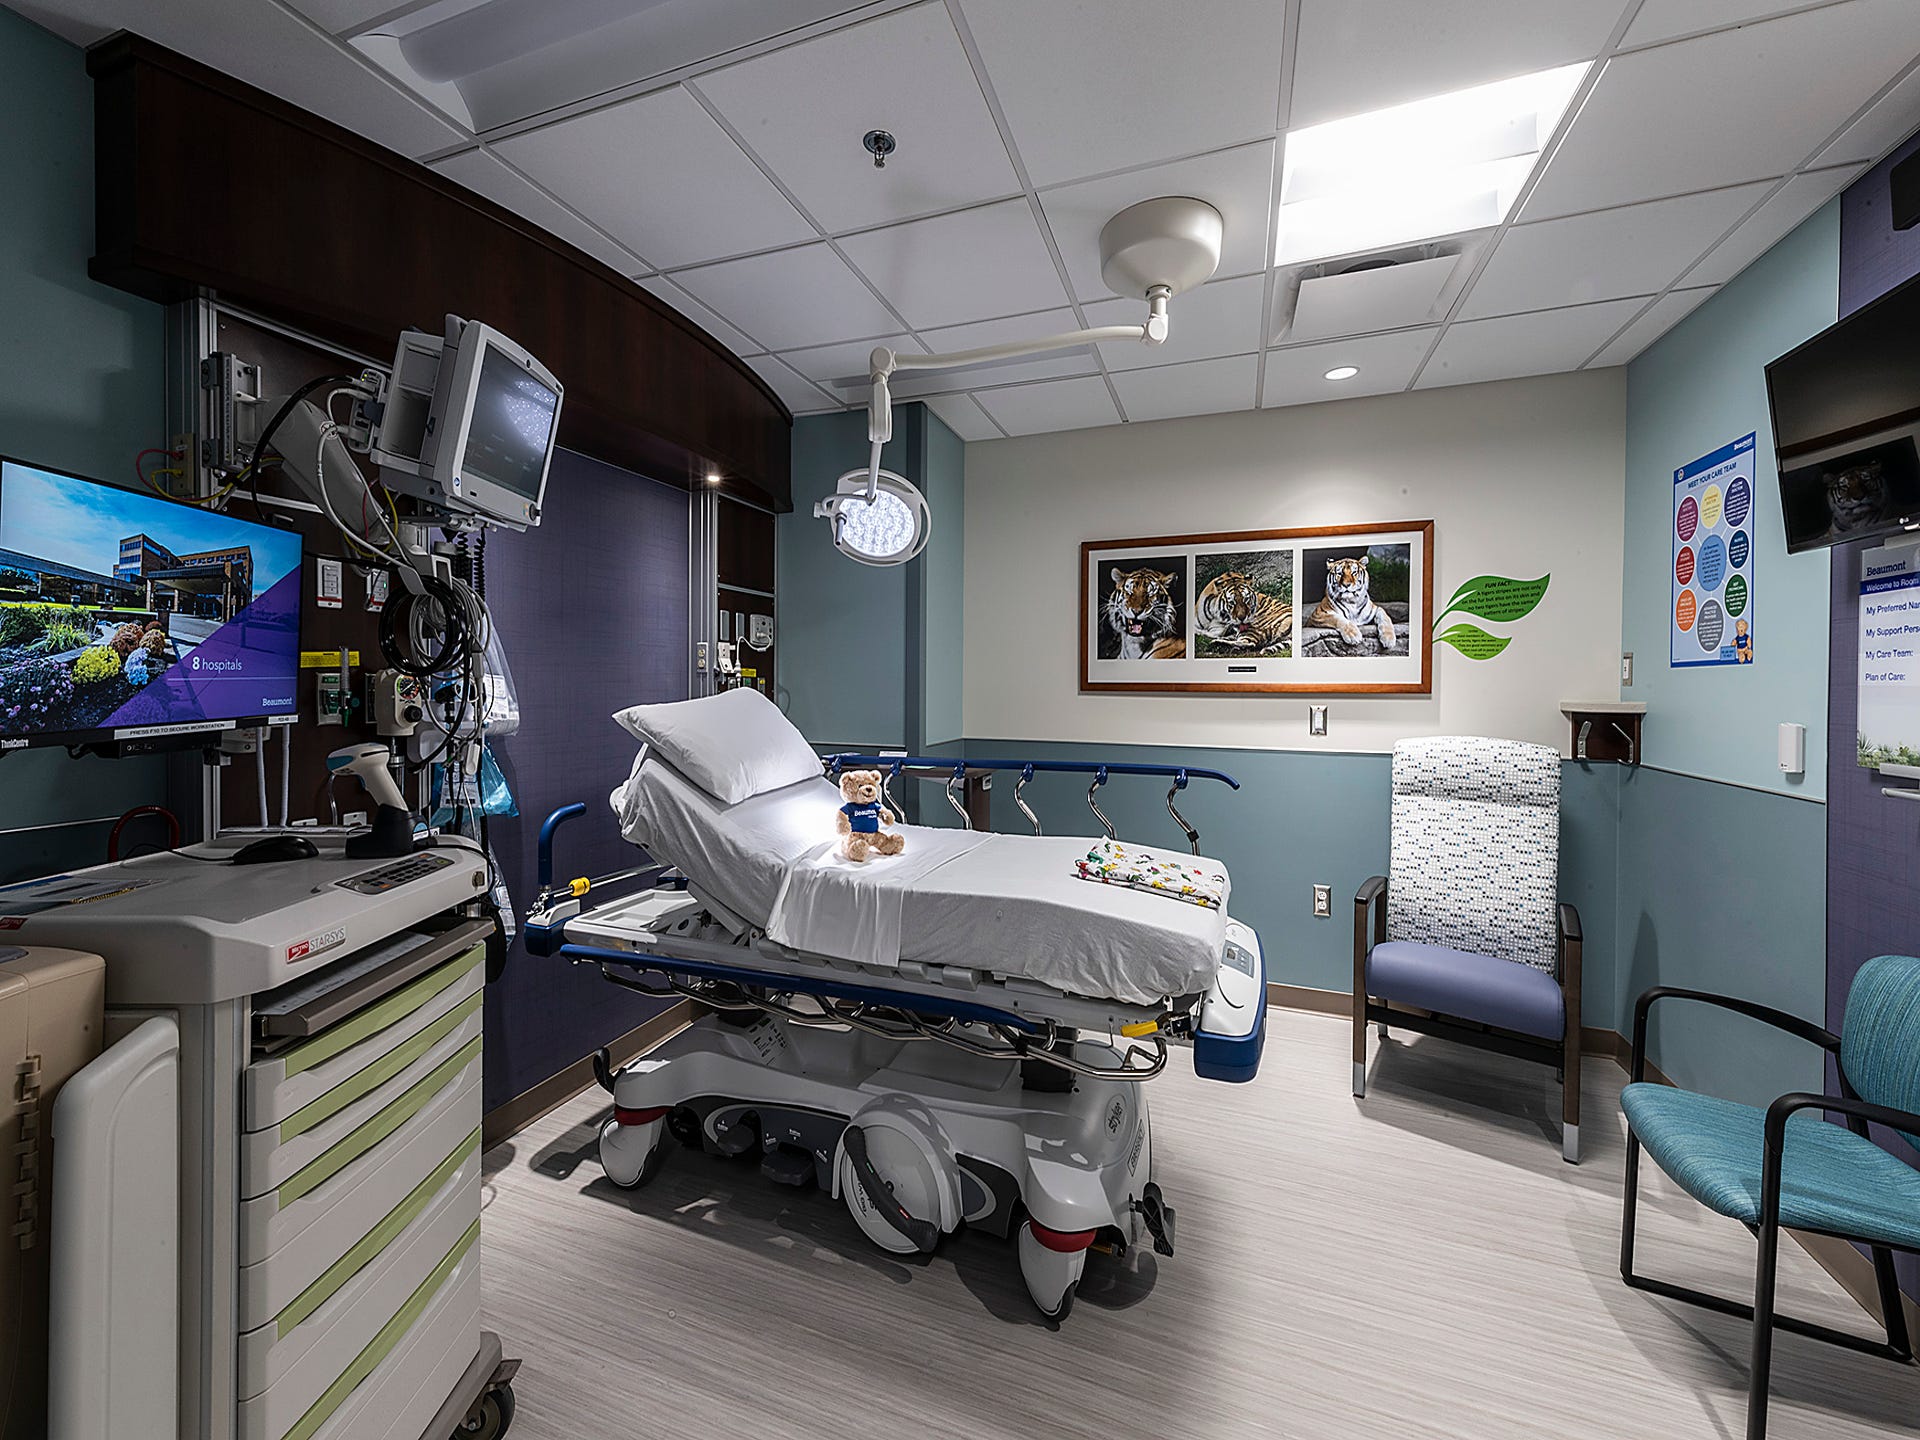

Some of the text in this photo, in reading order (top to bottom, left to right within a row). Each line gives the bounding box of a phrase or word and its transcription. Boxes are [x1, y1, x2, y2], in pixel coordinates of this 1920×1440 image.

[1688, 462, 1737, 489] MEET YOUR CARE TEAM
[1866, 561, 1906, 577] Beaumont
[1866, 582, 1892, 592] Welcome
[1893, 580, 1900, 588] to
[1866, 607, 1875, 616] My
[1877, 602, 1907, 613] Preferred
[1866, 625, 1920, 638] My Support Pers
[1865, 649, 1914, 660] My Care Team:
[192, 656, 242, 674] 8 hospitals
[1865, 673, 1879, 681] Plan
[1888, 672, 1906, 680] Care:
[262, 697, 292, 706] Beaumont
[190, 723, 225, 731] WORKSTATION
[1, 738, 29, 750] ThinkCentre
[310, 927, 345, 951] STARSYS
